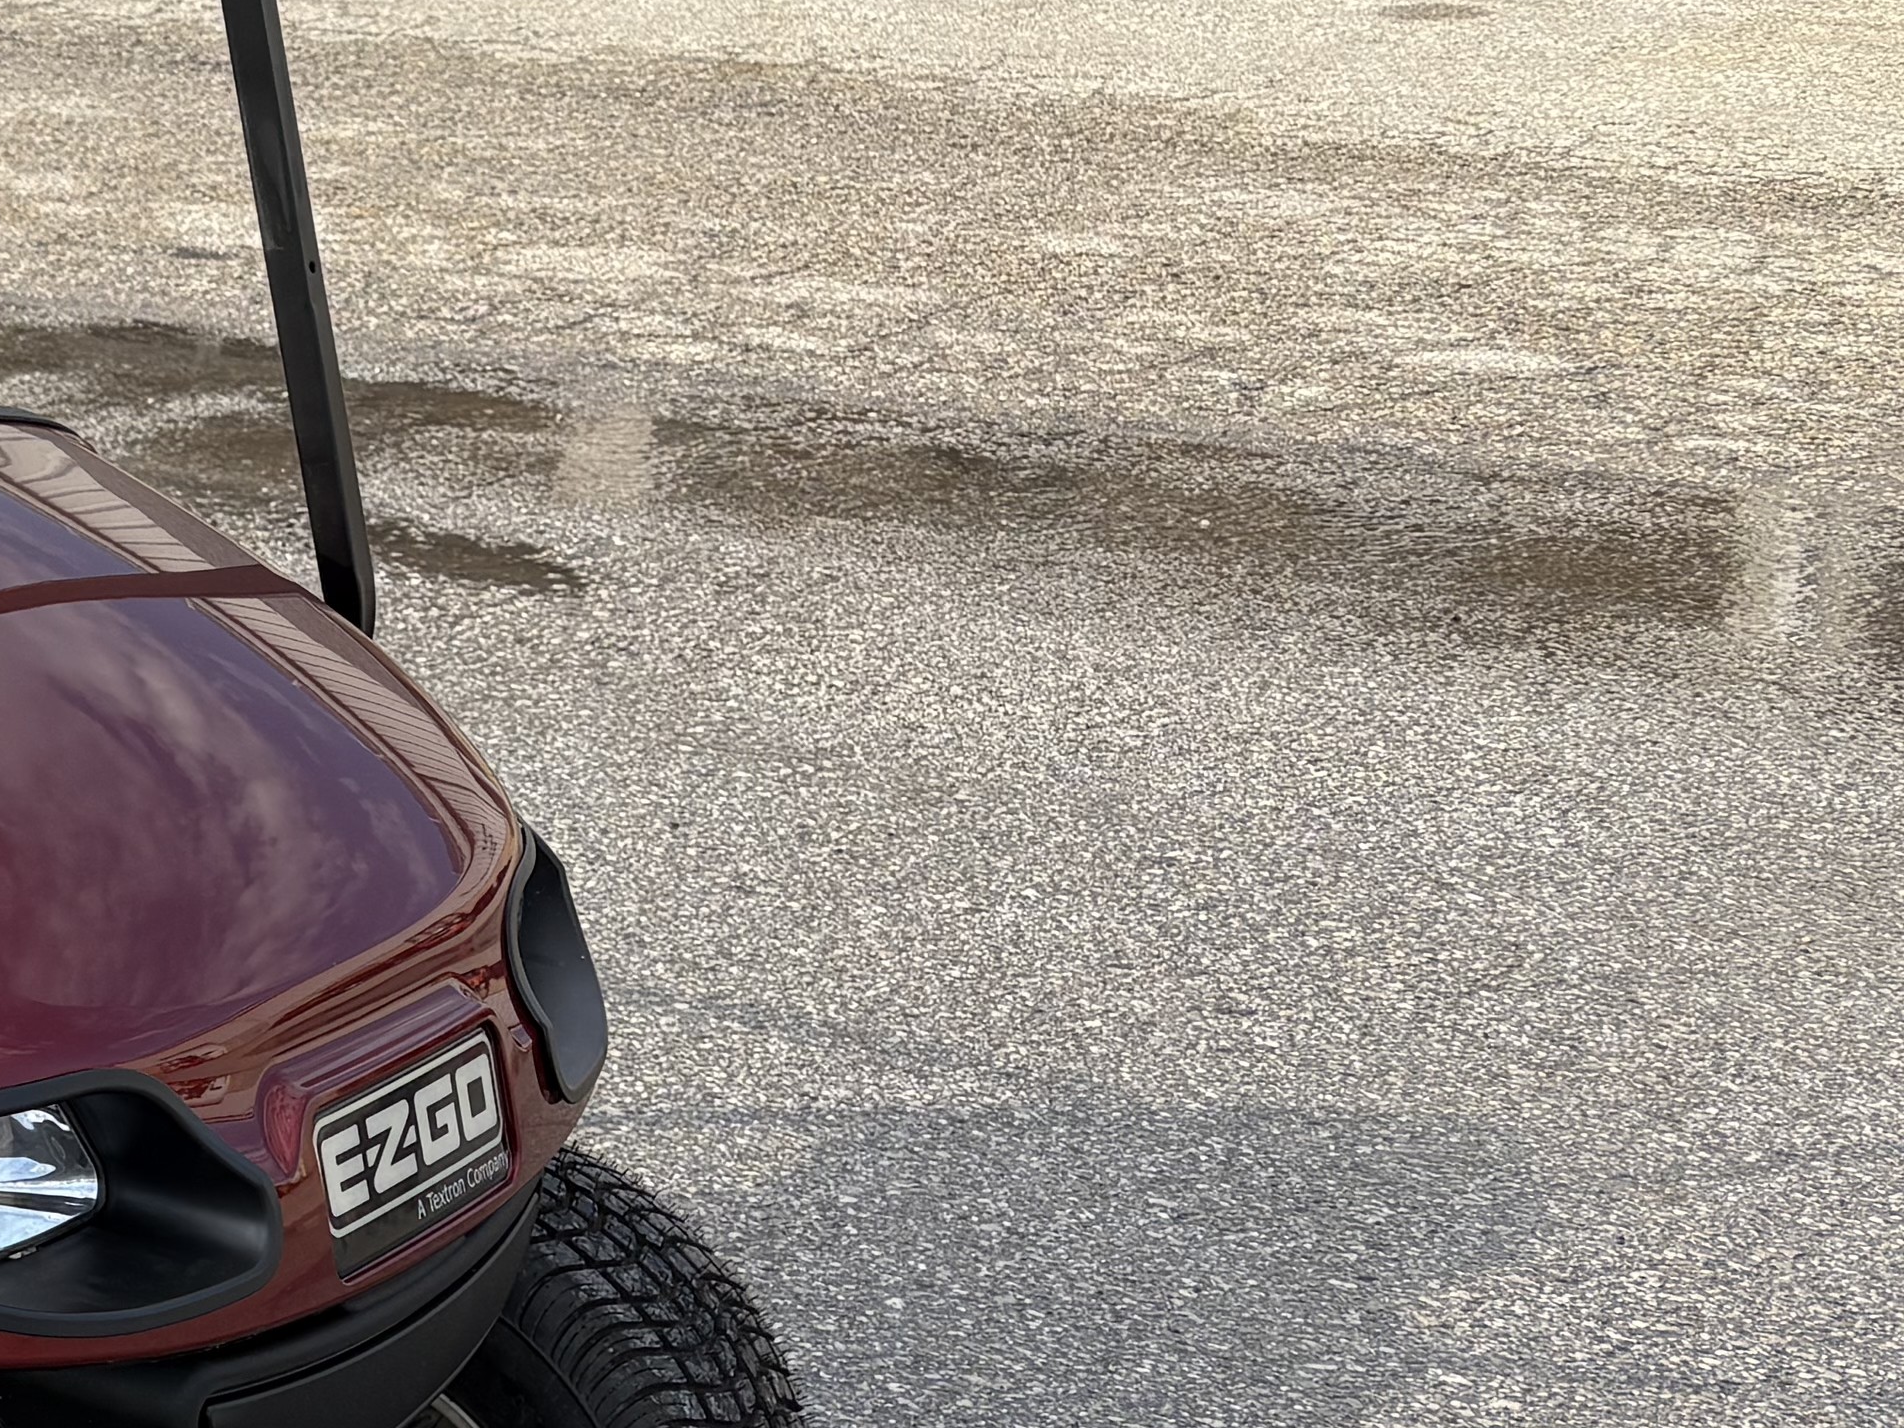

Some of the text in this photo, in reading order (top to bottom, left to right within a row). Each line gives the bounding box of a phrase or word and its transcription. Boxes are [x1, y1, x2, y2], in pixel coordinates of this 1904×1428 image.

[417, 1150, 511, 1219] A Textron Company
